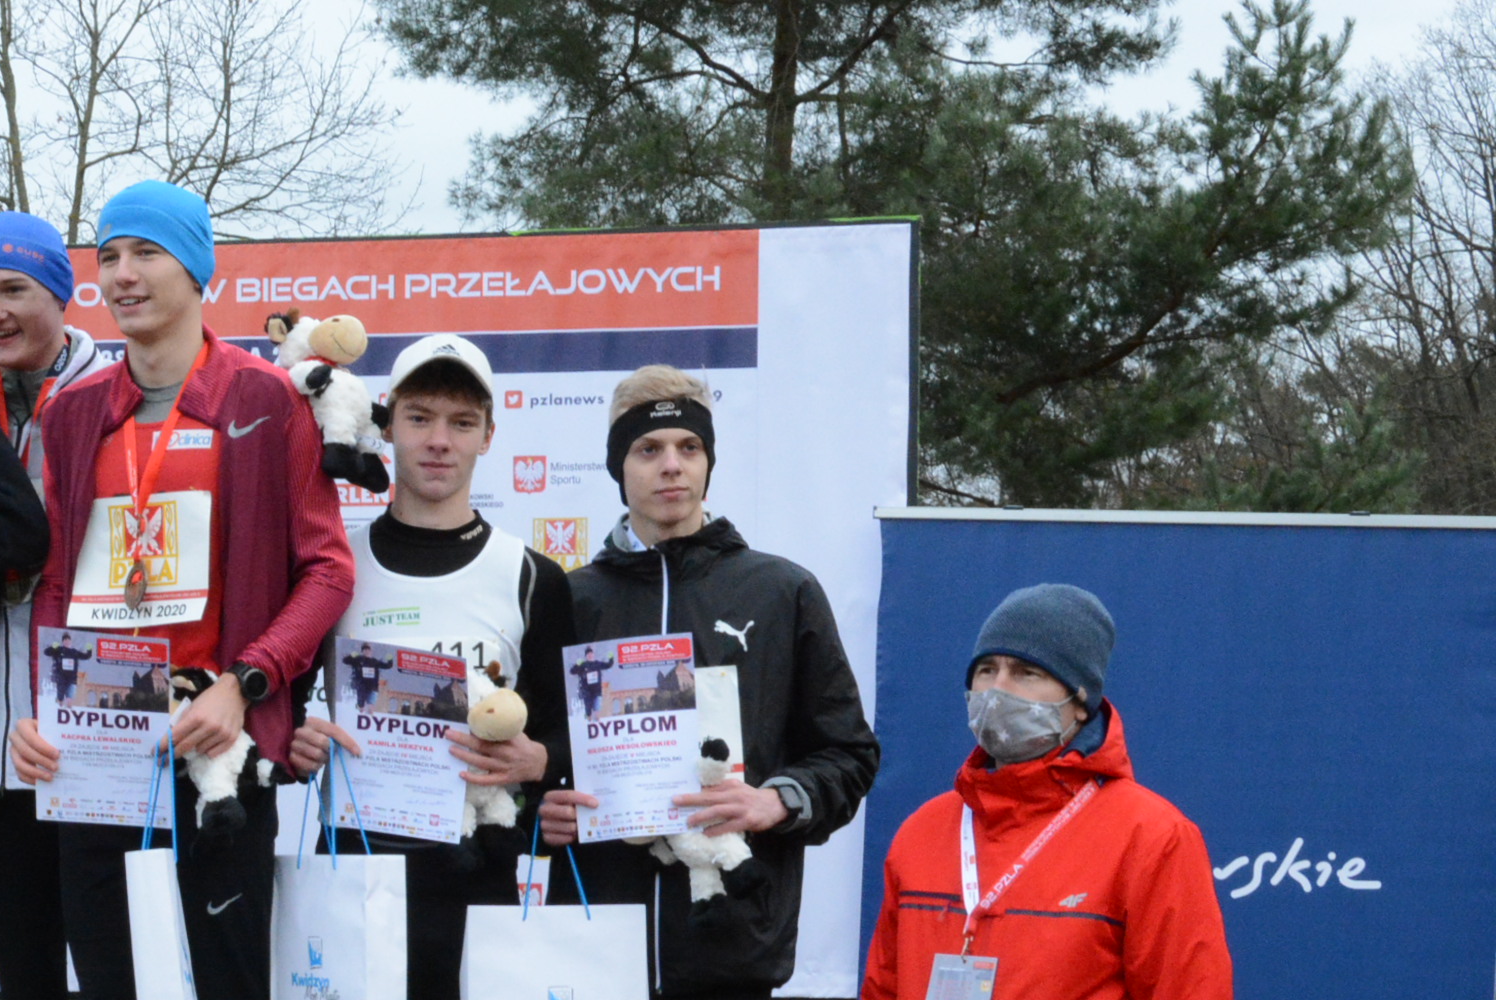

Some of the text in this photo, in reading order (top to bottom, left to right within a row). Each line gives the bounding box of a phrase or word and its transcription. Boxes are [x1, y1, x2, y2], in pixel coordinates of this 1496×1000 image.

[235, 275, 396, 303] BIEGACH
[404, 265, 721, 299] PRZEŁAJOWYCH
[530, 393, 605, 408] pzlanews
[550, 474, 581, 487] Sportu
[338, 486, 390, 503] RLEN
[113, 561, 174, 584] PLA
[91, 604, 187, 620] KWIDZYN 2020
[363, 612, 421, 627] JUST TEAM
[57, 708, 150, 732] DYPLOM
[356, 715, 451, 740] DYPLOM
[587, 715, 677, 740] DYPLOM
[994, 863, 1024, 893] PZLA
[1213, 837, 1382, 899] rskie
[291, 972, 331, 992] Kwidzyn
